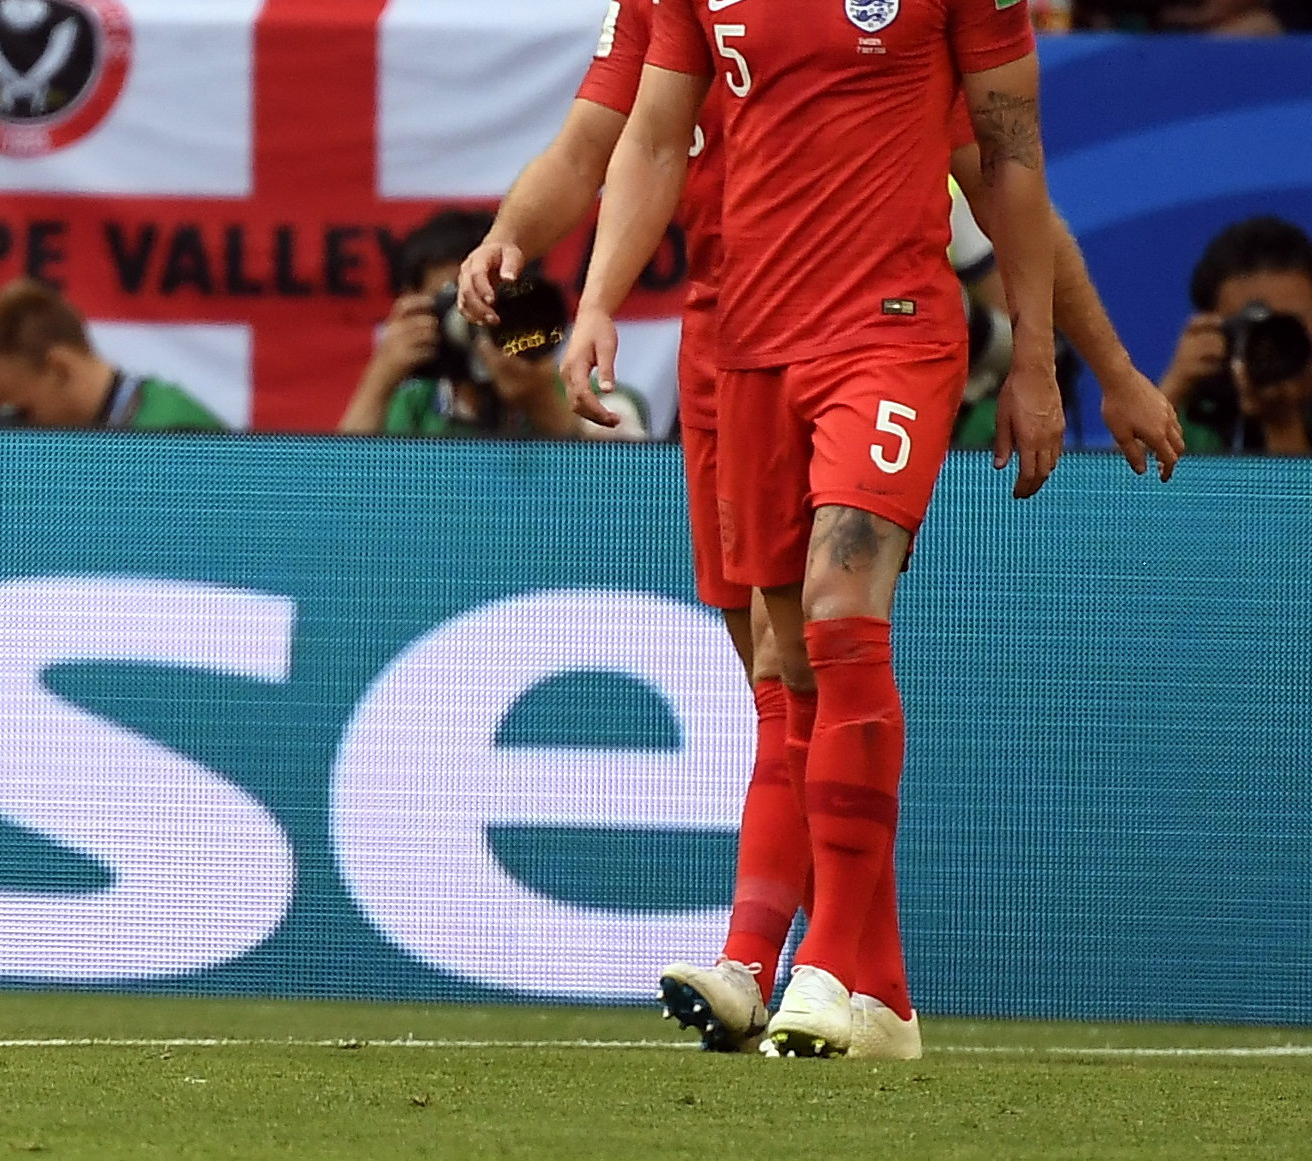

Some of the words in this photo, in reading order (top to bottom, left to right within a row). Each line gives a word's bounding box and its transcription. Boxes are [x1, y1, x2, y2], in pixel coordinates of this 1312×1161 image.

[714, 24, 752, 98] 5
[101, 217, 412, 298] VALLEY
[870, 399, 917, 474] 5
